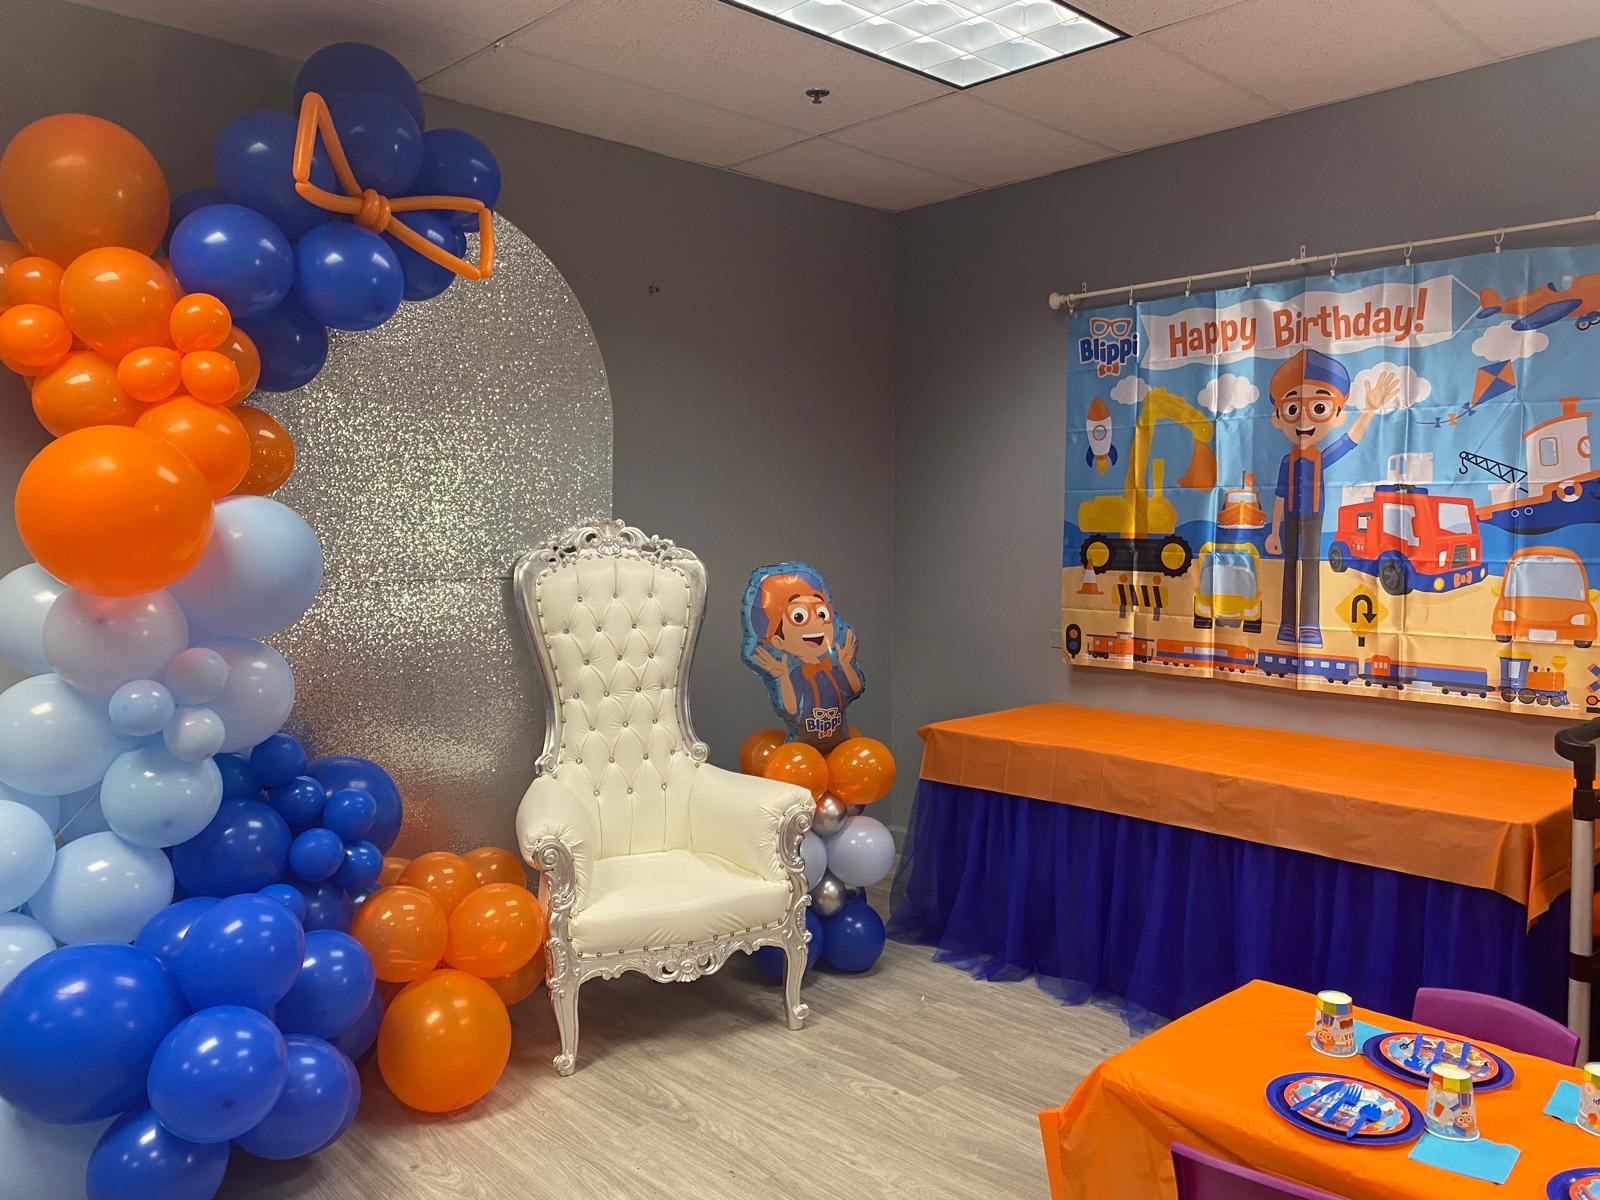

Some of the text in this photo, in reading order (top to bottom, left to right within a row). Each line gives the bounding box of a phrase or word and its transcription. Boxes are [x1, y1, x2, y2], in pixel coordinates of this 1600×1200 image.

[1168, 287, 1428, 359] Happy Birthday!
[1079, 333, 1138, 365] Blippi
[806, 713, 841, 732] Blippi
